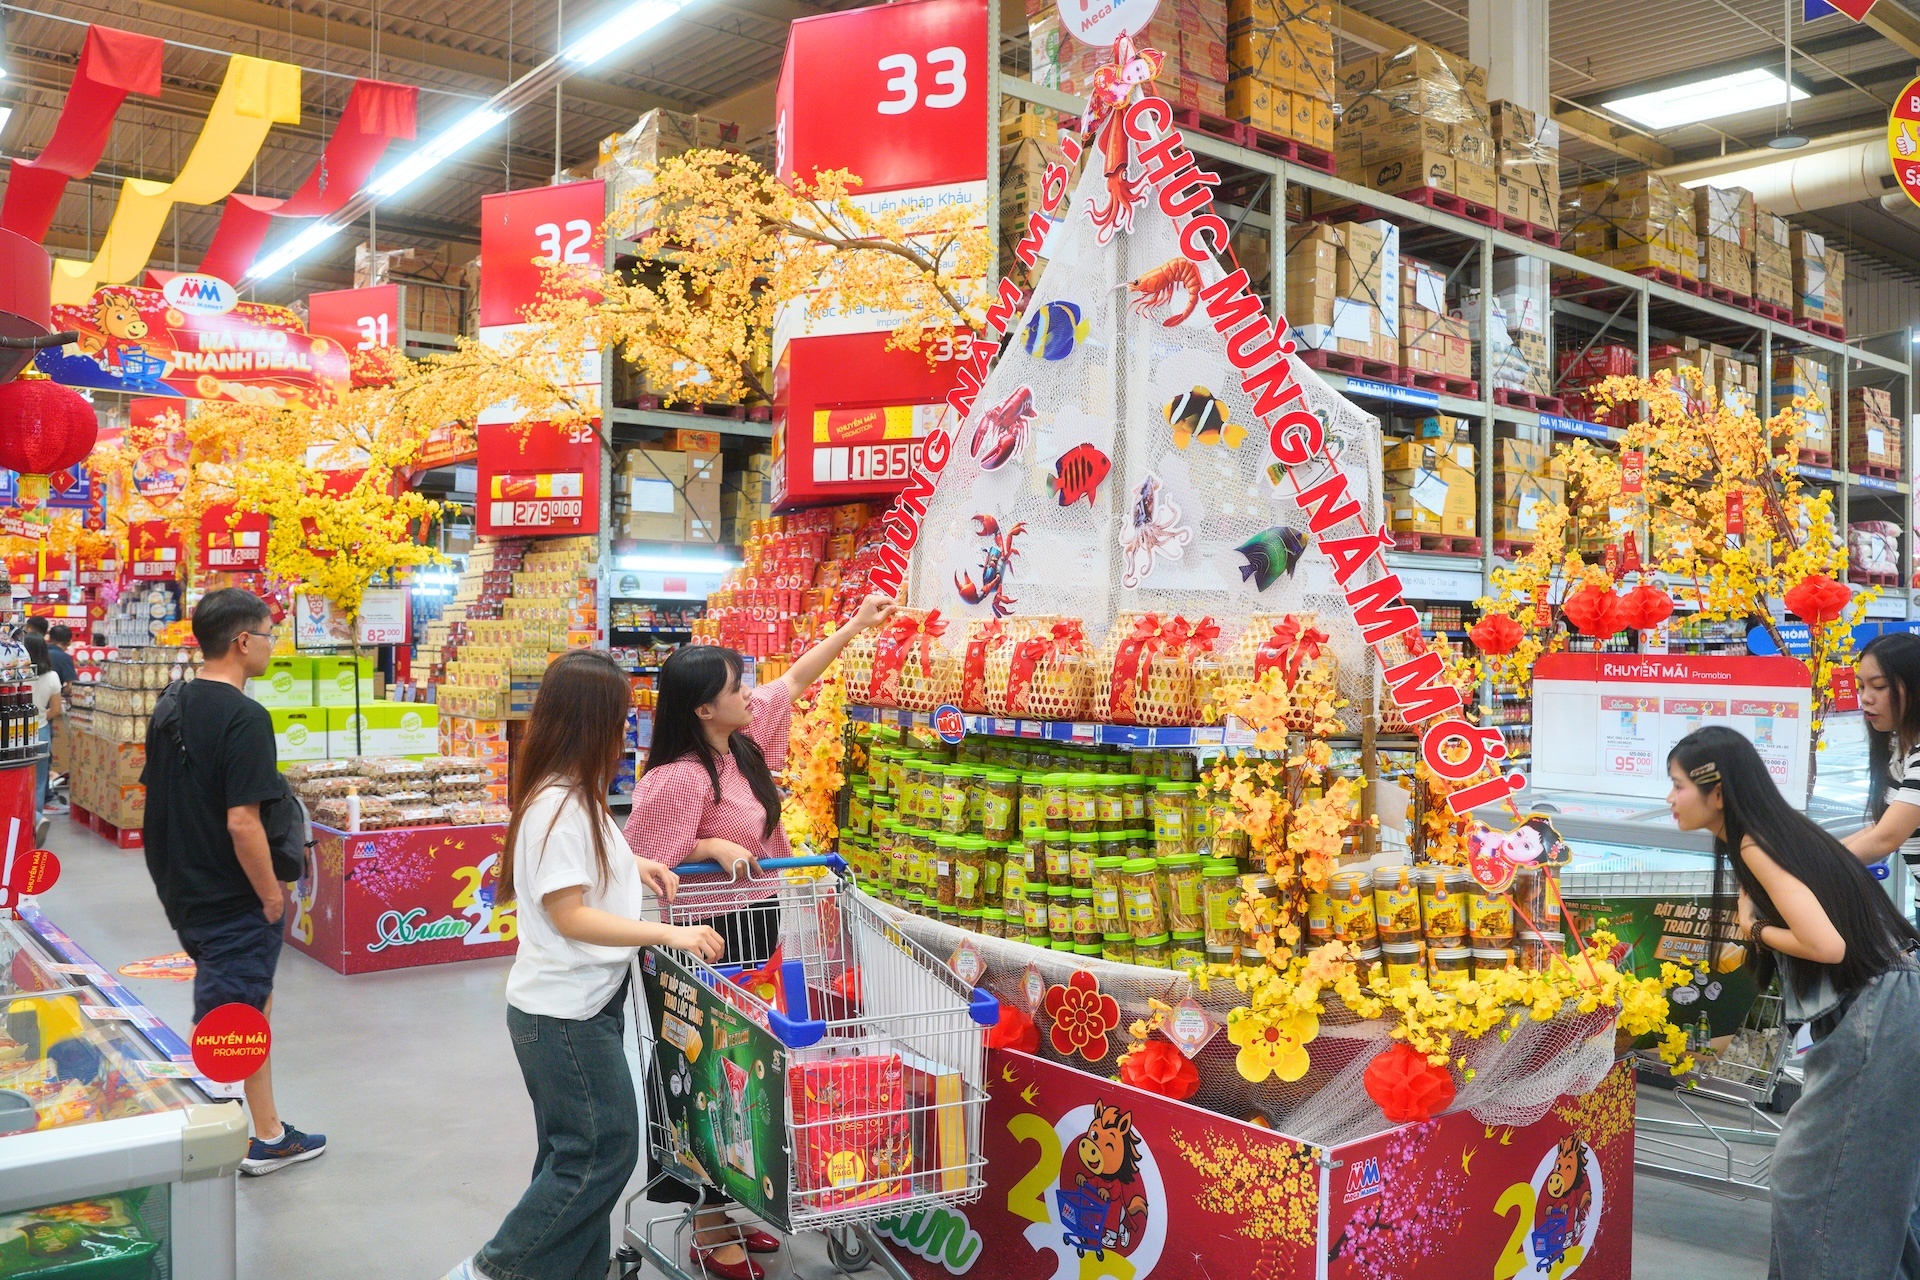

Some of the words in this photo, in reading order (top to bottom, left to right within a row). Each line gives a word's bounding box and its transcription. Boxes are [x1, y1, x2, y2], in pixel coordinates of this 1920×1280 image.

[1081, 5, 1112, 32] Mega
[877, 46, 967, 115] 33
[870, 197, 897, 215] Liền
[901, 196, 933, 212] Nhập
[938, 188, 972, 208] Khẩu
[535, 219, 592, 264] 32
[176, 299, 196, 310] Mega
[196, 301, 223, 312] Market
[356, 313, 388, 350] 31
[172, 351, 256, 372] THÀNH
[257, 352, 312, 372] DEAL
[835, 417, 863, 434] KHUYẾN
[863, 412, 877, 424] MÃI
[841, 423, 873, 440] PROMOTION
[1541, 416, 1550, 427] GIA
[1551, 418, 1558, 430] VỊ
[1558, 418, 1571, 430] THÁI
[1572, 422, 1583, 432] LAN
[868, 427, 951, 600] MỪNG
[946, 275, 1024, 419] NĂM
[1123, 96, 1230, 264] CHÚC
[1198, 268, 1326, 467] MỪNG
[1295, 472, 1420, 645] NĂM
[1384, 652, 1527, 816] MỚI
[58, 474, 65, 485] Ý
[1662, 664, 1688, 679] MÃI
[1692, 670, 1732, 680] Promotion
[937, 711, 963, 734] MỚI
[26, 866, 38, 893] KHUYẾN
[33, 851, 41, 866] MÃI
[37, 852, 48, 883] PROMOTION
[1591, 904, 1613, 913] SPECIAL
[1653, 902, 1671, 919] BẬT
[1673, 901, 1697, 917] NẮP
[367, 907, 472, 952] Xuân
[1663, 918, 1692, 935] TRAO
[664, 990, 678, 1012] TRAO
[678, 979, 698, 1005] SPECIAL
[196, 1030, 243, 1046] KHUYẾN
[246, 1033, 267, 1045] MÃI
[213, 1047, 266, 1057] PROMOTION
[835, 1120, 864, 1133] bless
[1343, 1192, 1360, 1203] Mega
